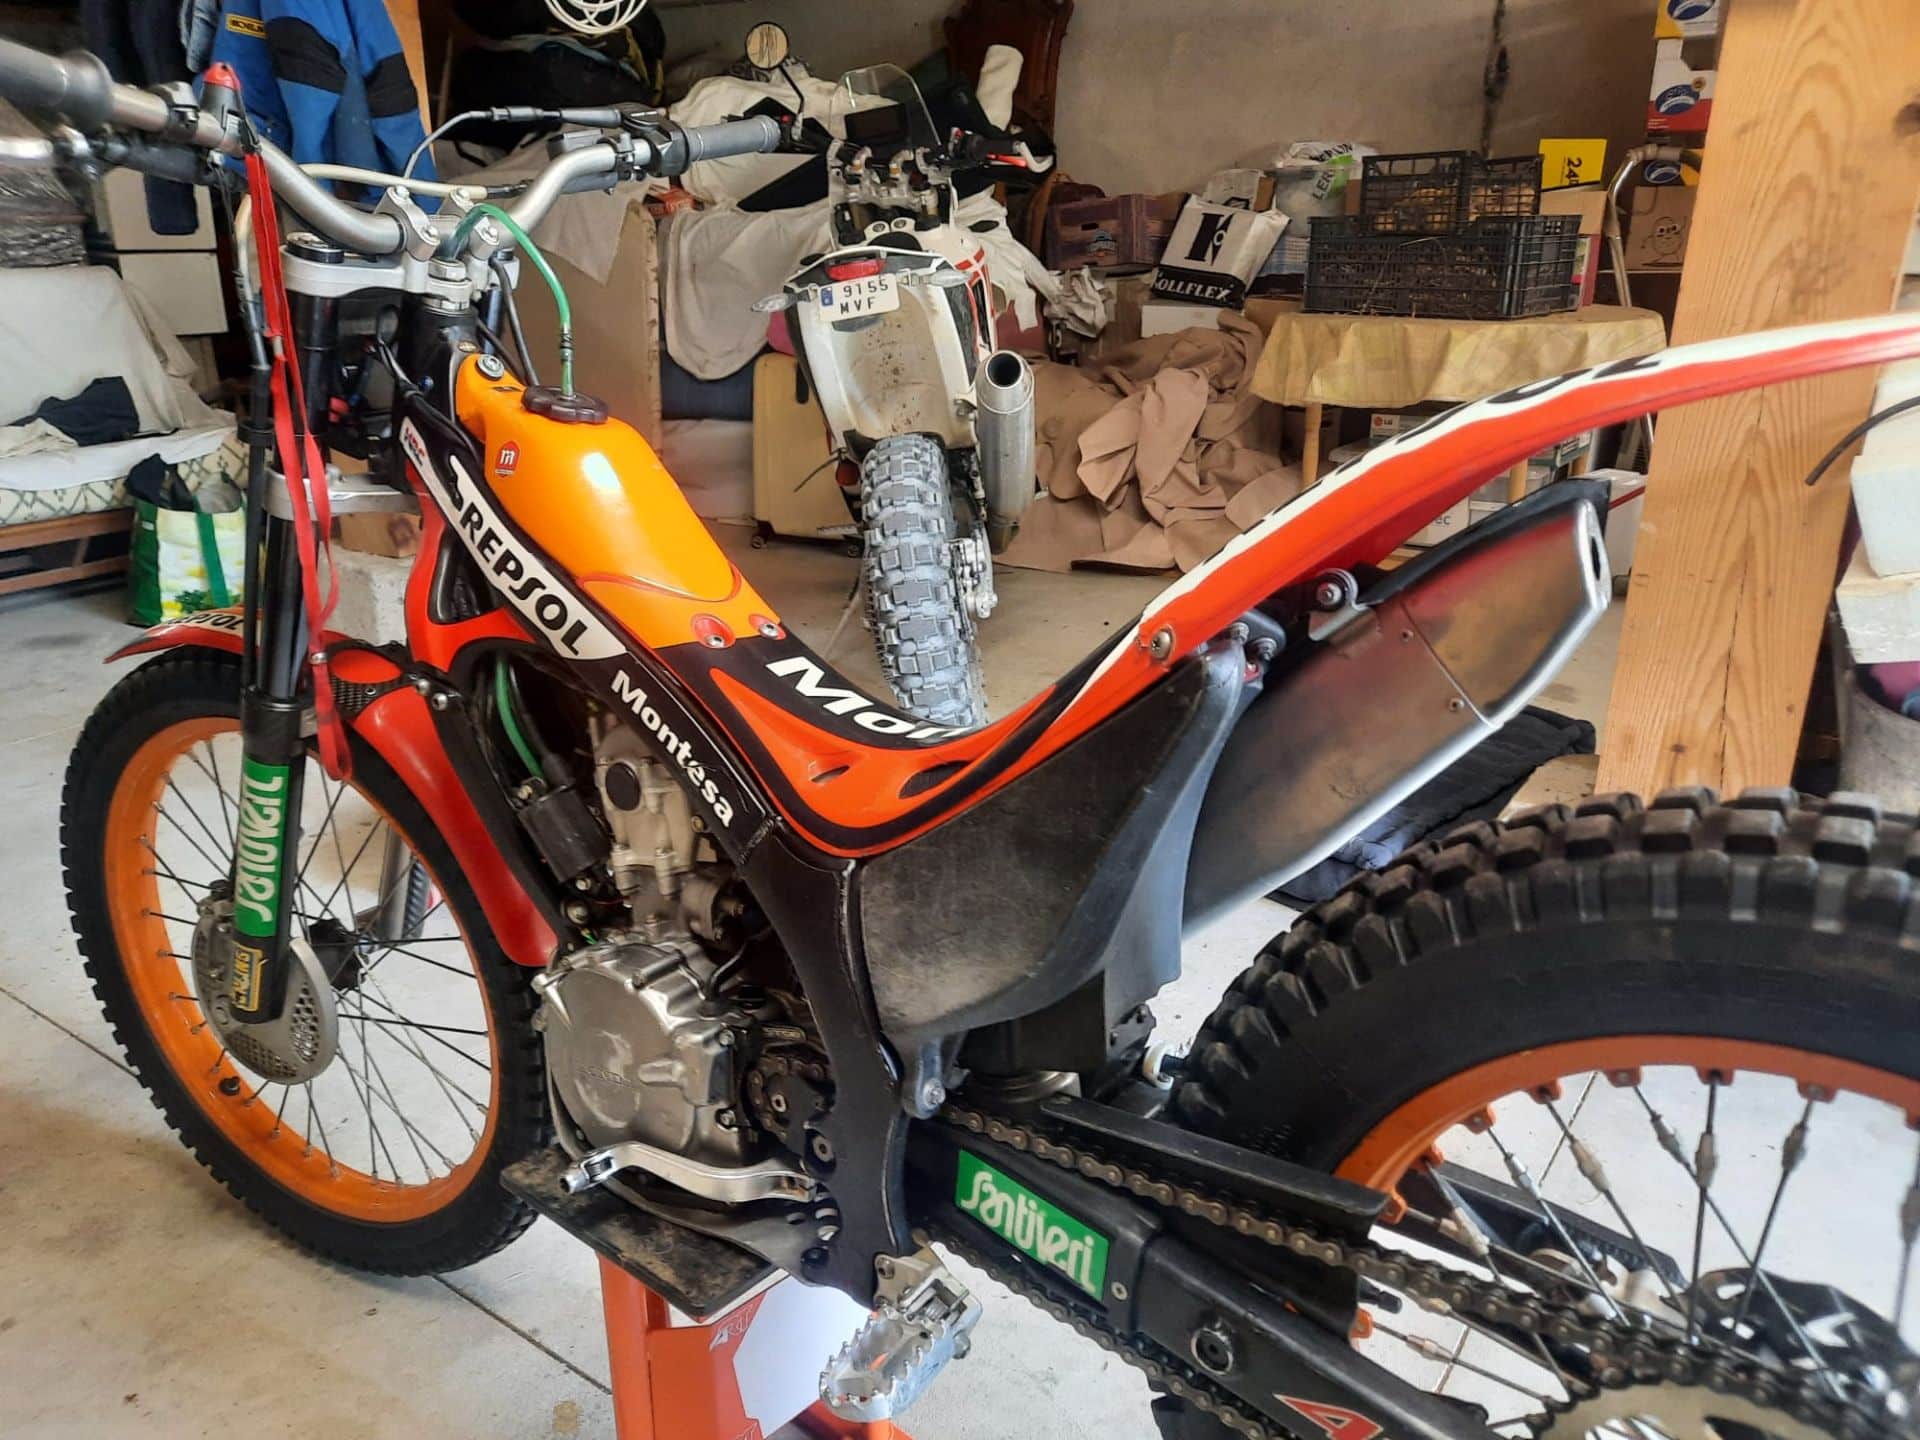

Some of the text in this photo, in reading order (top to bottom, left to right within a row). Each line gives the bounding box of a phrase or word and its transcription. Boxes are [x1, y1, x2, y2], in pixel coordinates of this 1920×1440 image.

[840, 297, 876, 315] MVF
[843, 279, 889, 298] 9155
[460, 501, 589, 656] REPSOL
[610, 669, 734, 828] Montesa
[960, 1171, 1096, 1294] Santiveri
